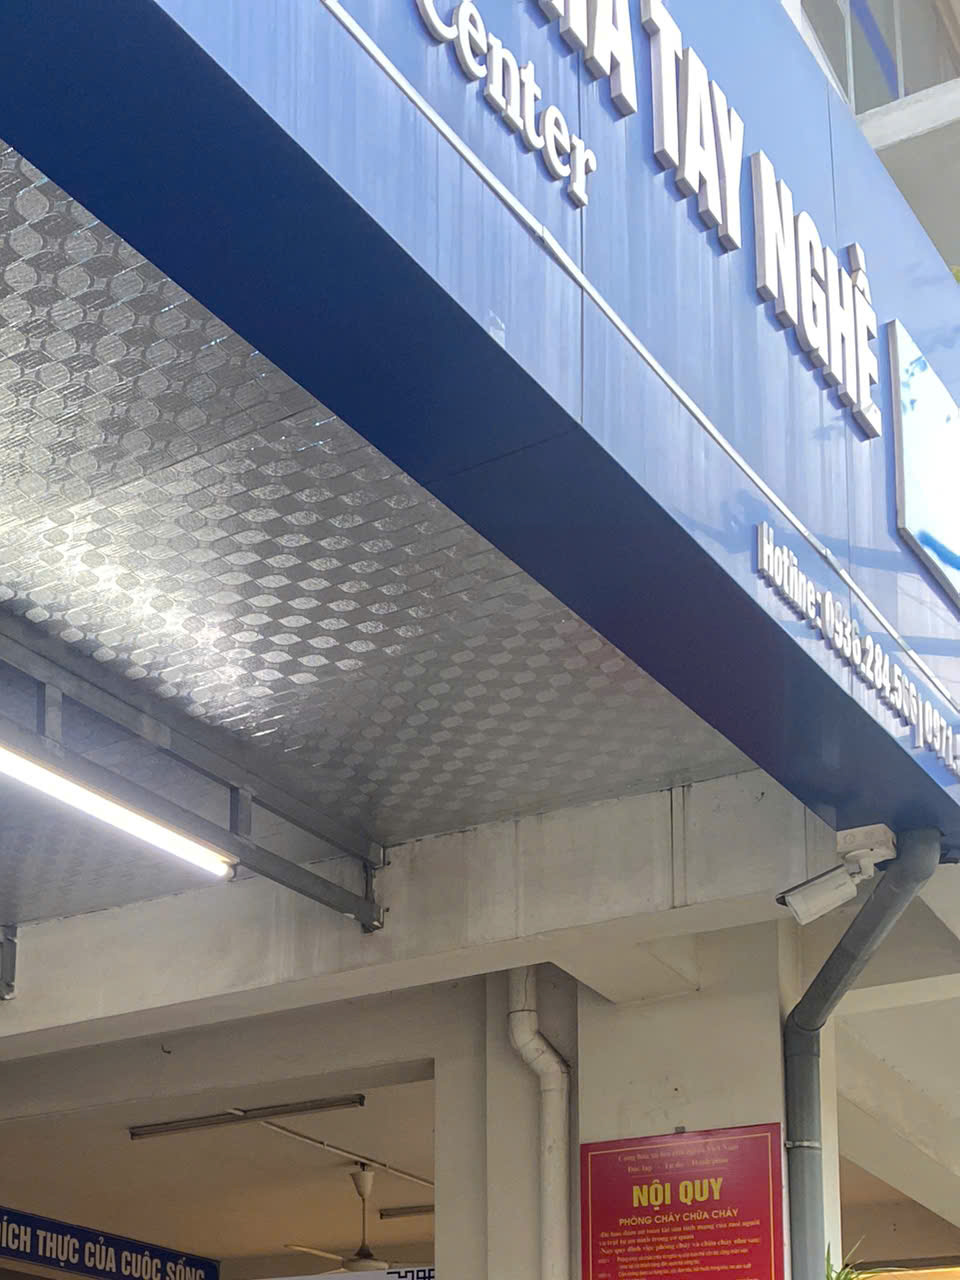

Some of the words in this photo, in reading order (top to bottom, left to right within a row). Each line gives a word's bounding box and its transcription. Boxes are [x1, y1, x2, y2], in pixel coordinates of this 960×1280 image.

[641, 0, 743, 250] TAY
[751, 150, 881, 438] NGHỀ
[757, 521, 822, 628] Hotline:
[632, 1179, 671, 1211] NỘI
[679, 1177, 724, 1206] QUY
[619, 1214, 652, 1227] PHÒNG
[654, 1212, 681, 1225] CHÁY
[683, 1210, 709, 1222] CHỮA
[711, 1208, 738, 1219] CHÁY
[36, 1229, 79, 1267] THỰC
[84, 1236, 116, 1273] CỦA
